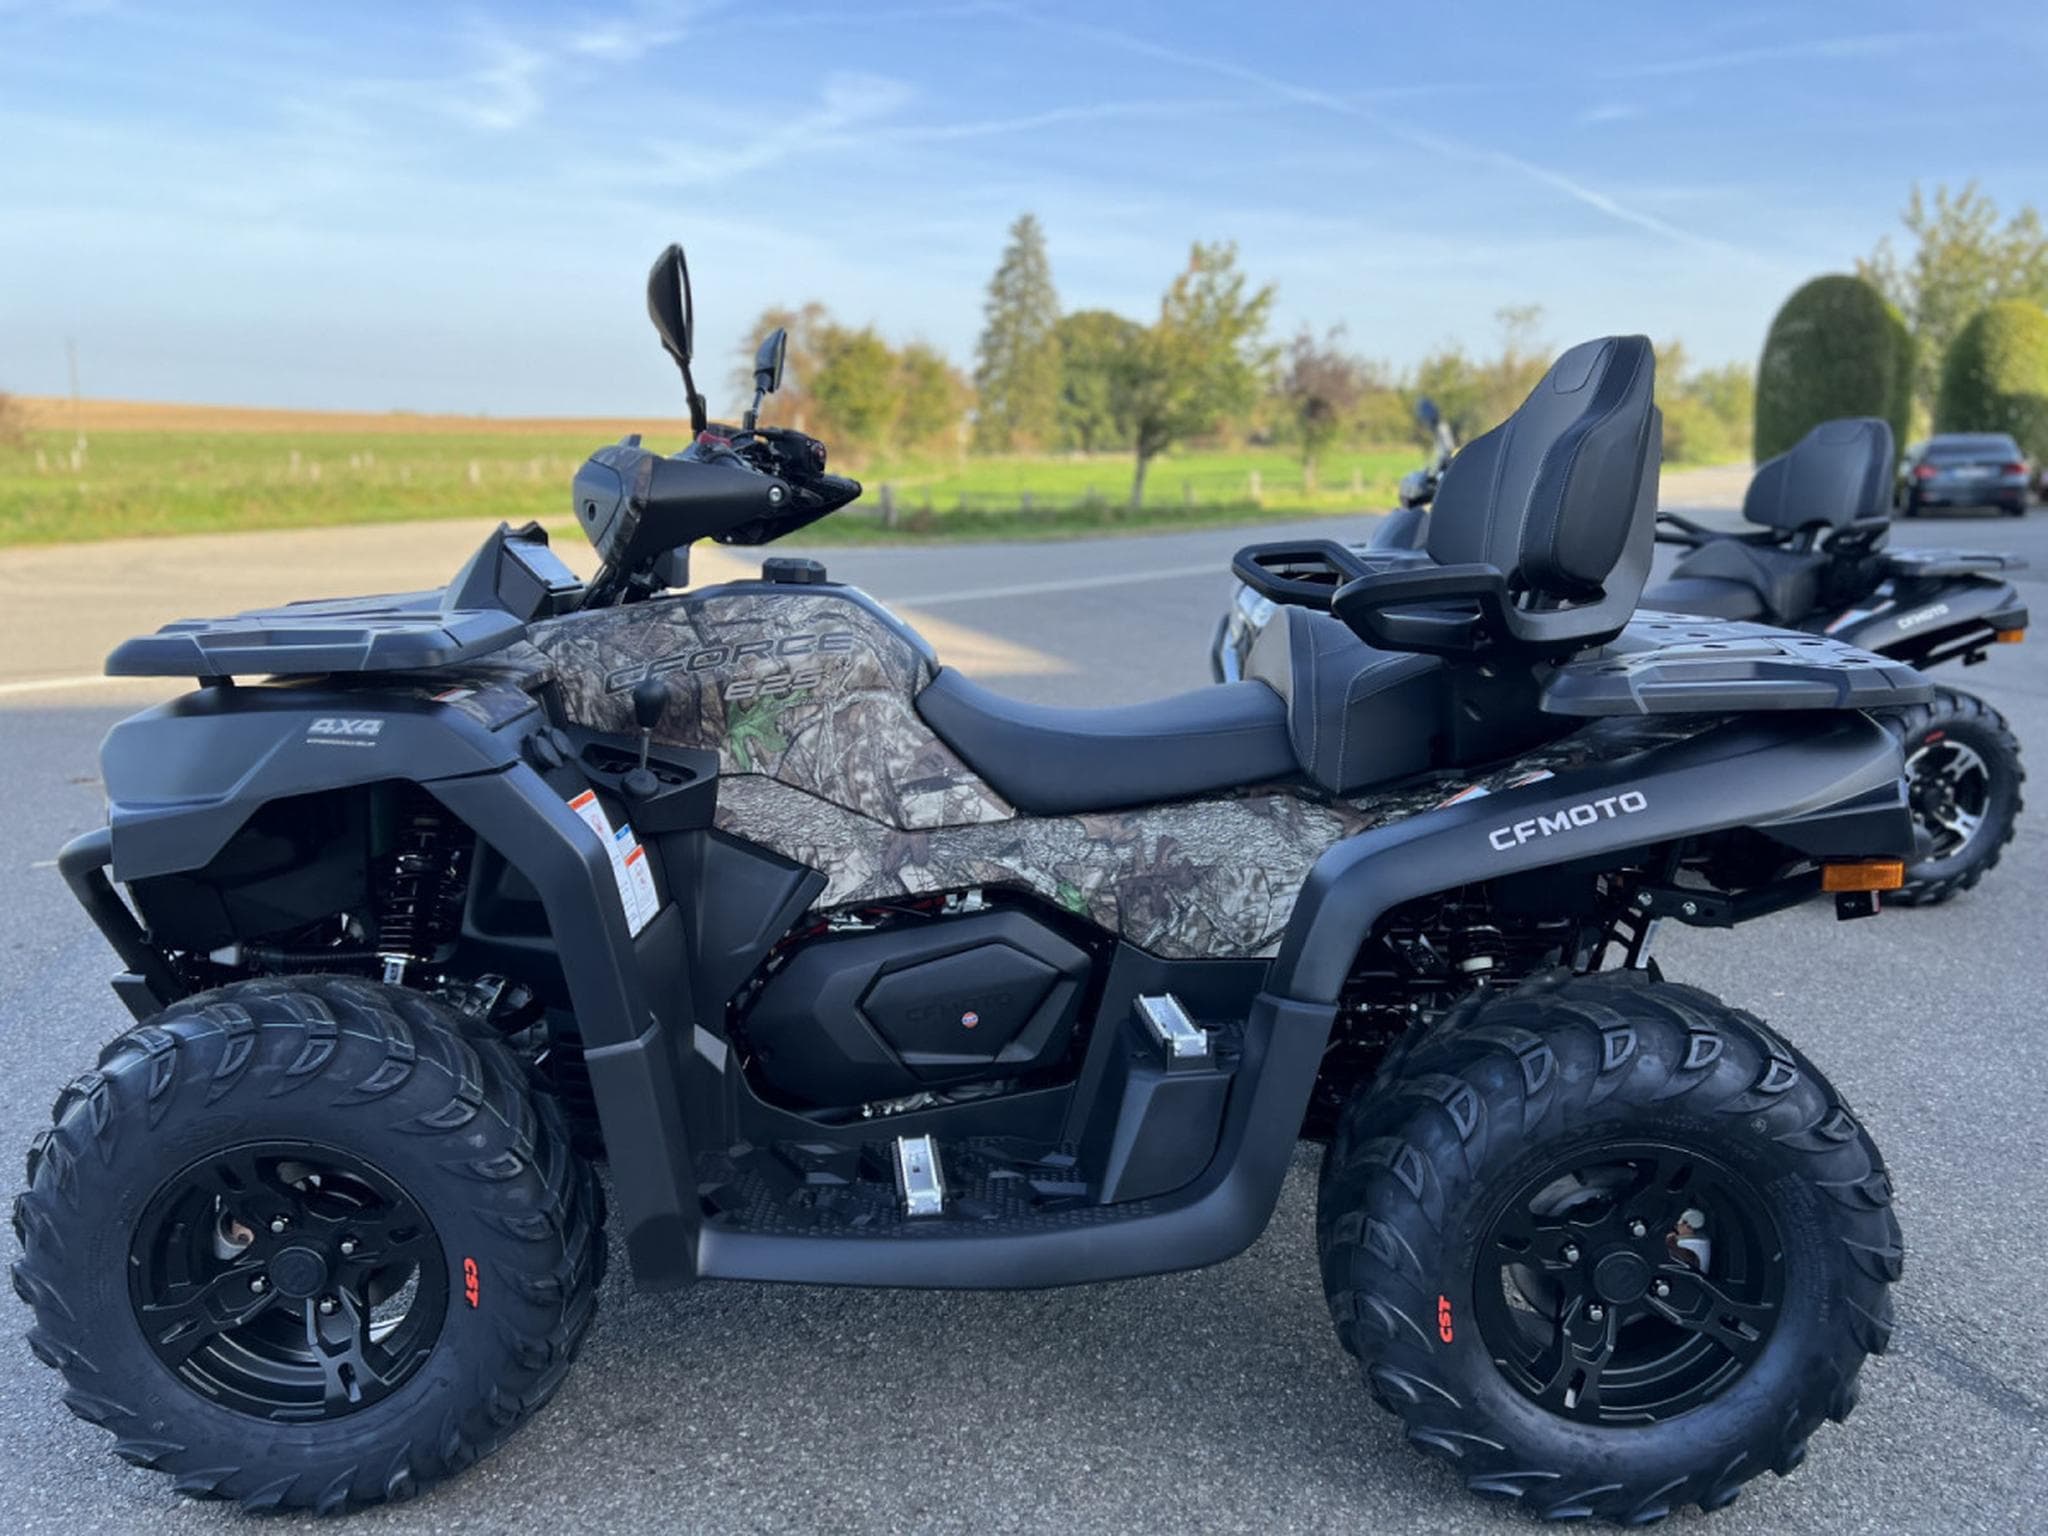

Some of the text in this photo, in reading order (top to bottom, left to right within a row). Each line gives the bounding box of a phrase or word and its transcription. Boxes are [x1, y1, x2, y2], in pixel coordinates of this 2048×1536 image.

[604, 631, 854, 695] CFORCE
[723, 667, 829, 701] 625
[306, 718, 384, 736] 4X4
[1488, 790, 1648, 851] CFMOTO
[463, 1257, 479, 1309] CST
[1438, 1294, 1454, 1343] CST
